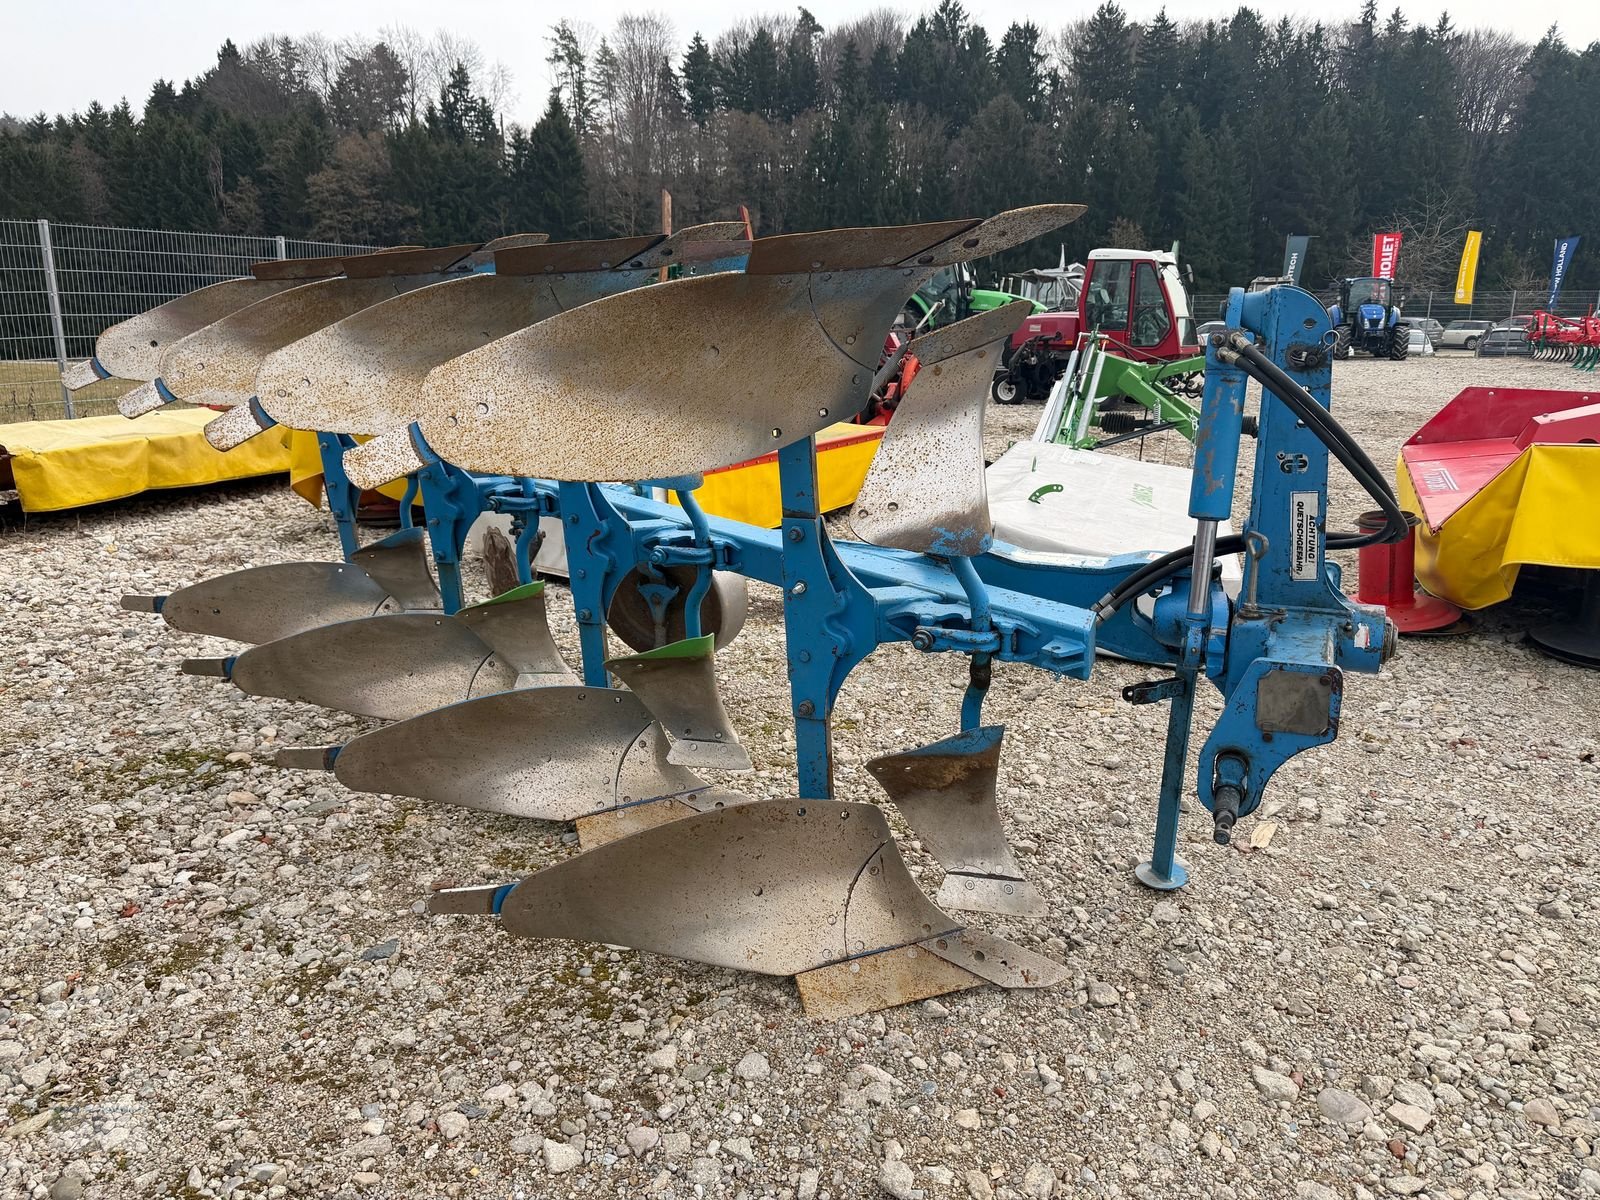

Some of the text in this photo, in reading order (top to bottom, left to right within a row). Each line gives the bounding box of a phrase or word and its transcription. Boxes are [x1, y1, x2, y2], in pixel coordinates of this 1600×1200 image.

[1379, 235, 1394, 281] RIOLIET
[1555, 242, 1568, 276] HOLLAND
[1308, 514, 1316, 563] ACHTUNG!
